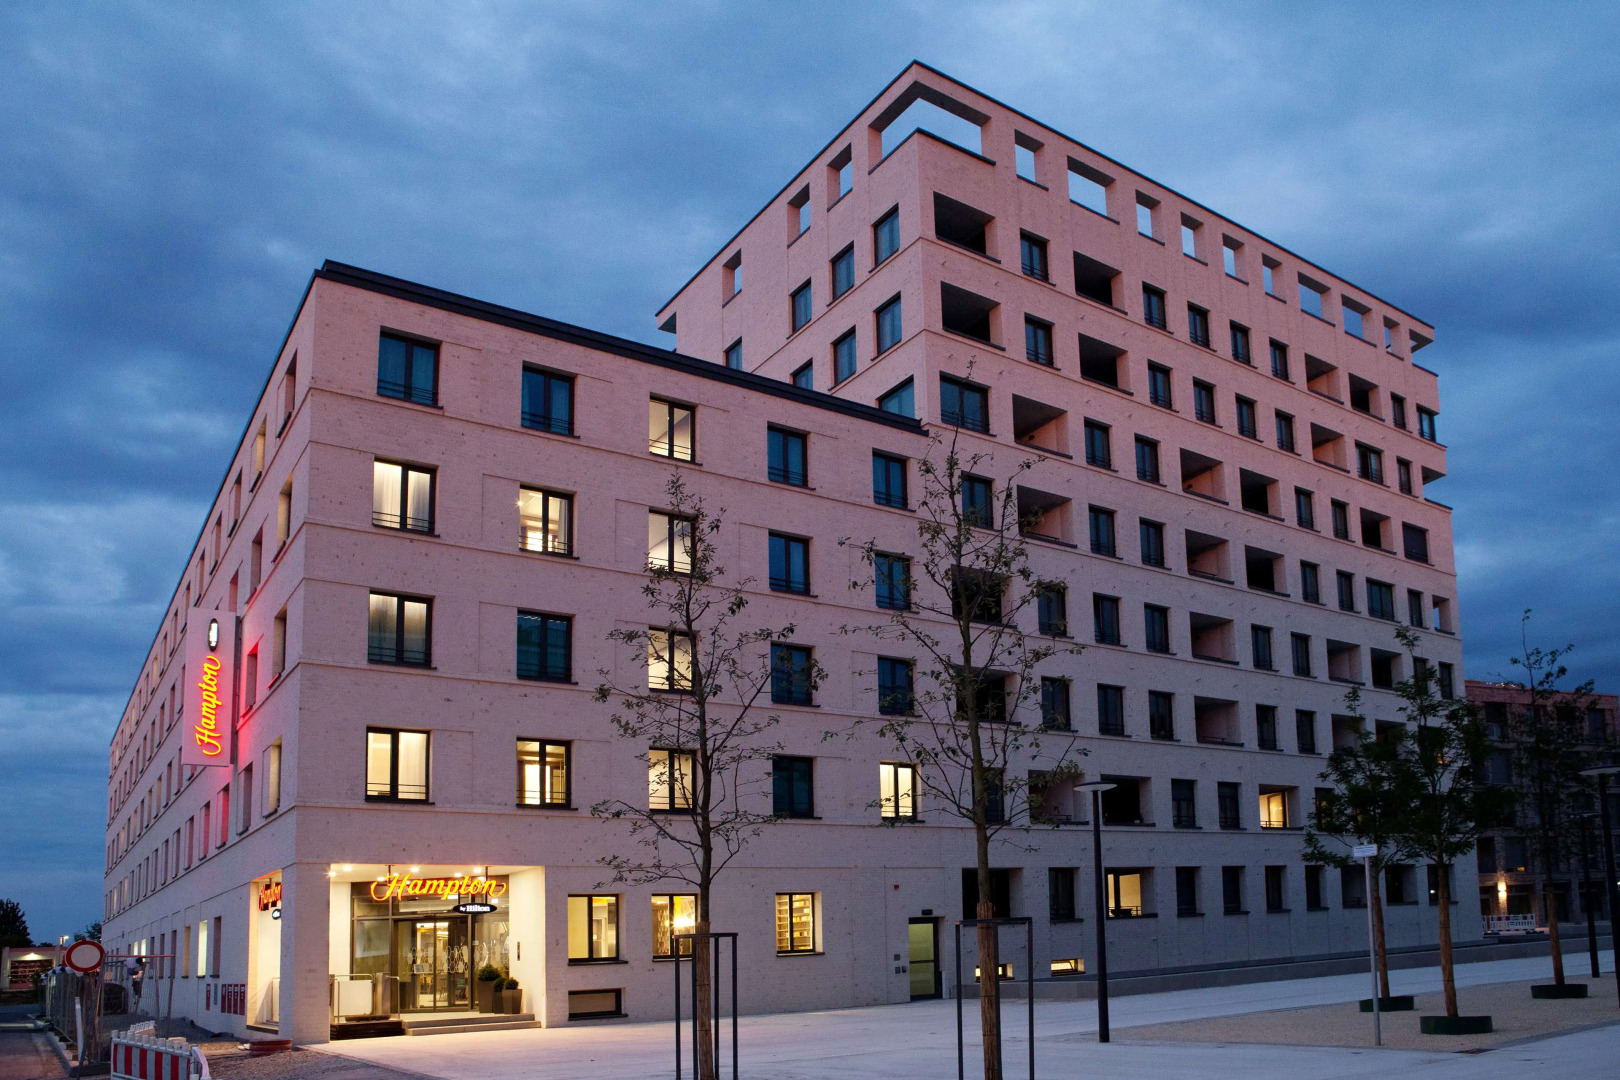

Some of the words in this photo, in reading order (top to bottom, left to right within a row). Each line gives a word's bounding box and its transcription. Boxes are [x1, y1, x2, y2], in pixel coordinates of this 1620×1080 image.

[194, 655, 223, 756] Hampton
[370, 872, 507, 901] Hampton
[466, 904, 491, 912] Hilton
